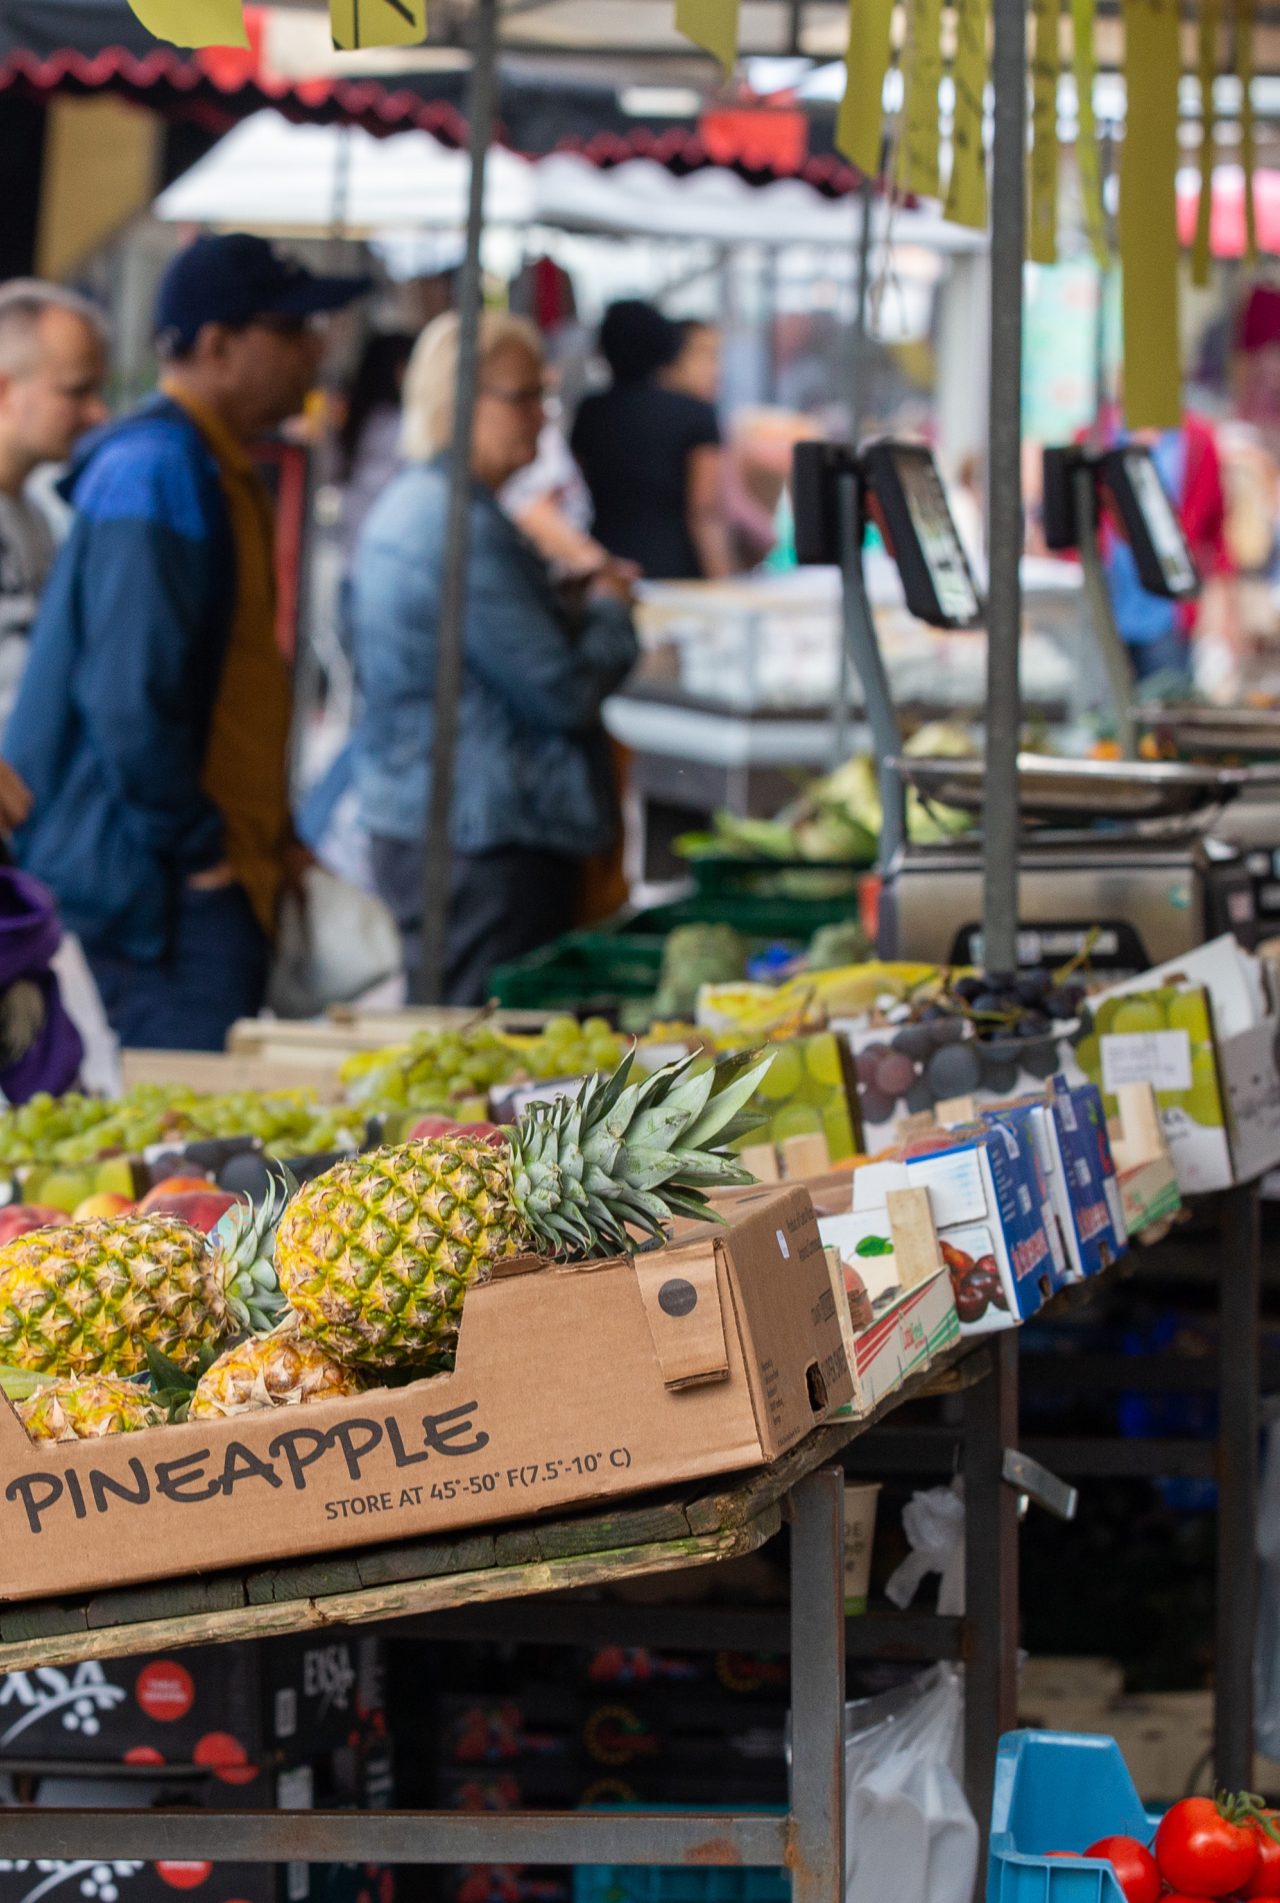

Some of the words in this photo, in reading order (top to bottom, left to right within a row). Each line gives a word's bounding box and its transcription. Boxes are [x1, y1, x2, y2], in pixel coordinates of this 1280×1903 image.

[5, 1400, 490, 1534] PINEAPPLE
[325, 1492, 393, 1520] STORE
[399, 1486, 424, 1508] AT
[430, 1472, 500, 1501] 45°-50°
[609, 1447, 632, 1468] C)
